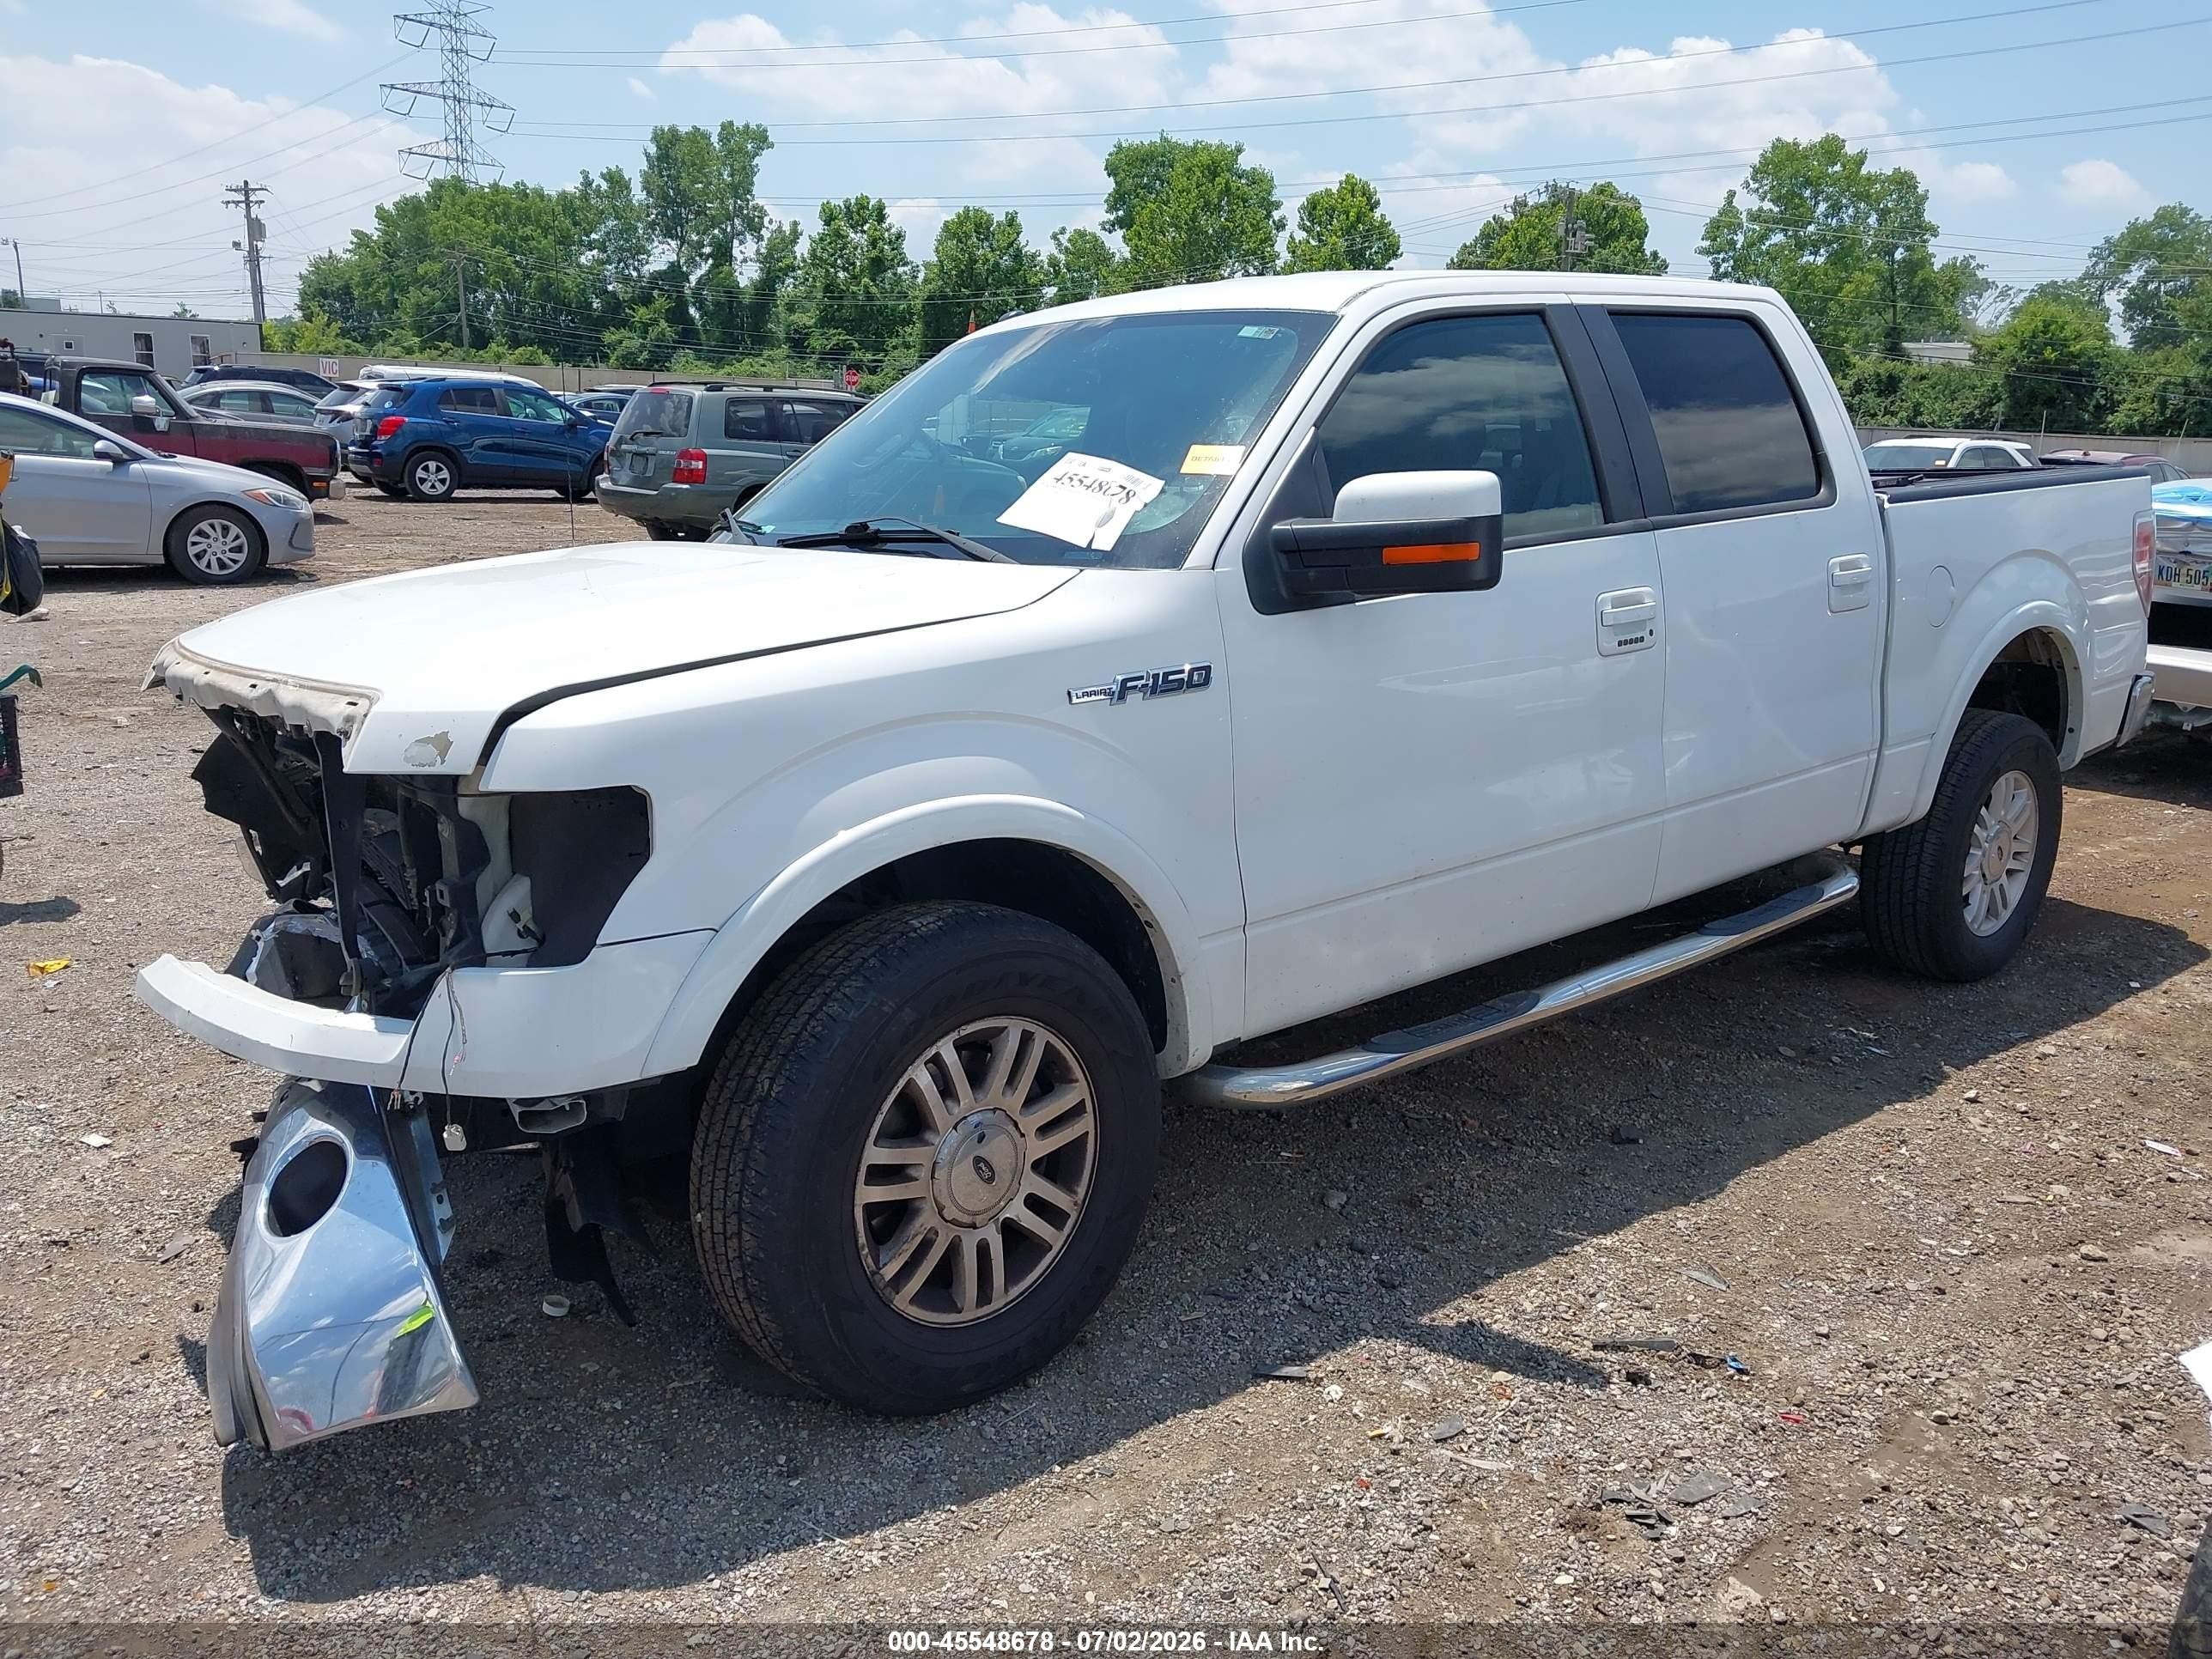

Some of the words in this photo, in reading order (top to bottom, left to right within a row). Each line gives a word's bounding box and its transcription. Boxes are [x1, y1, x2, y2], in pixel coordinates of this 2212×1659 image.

[320, 361, 338, 375] VIC
[2157, 564, 2182, 583] KDH
[2185, 568, 2212, 586] 505
[1116, 664, 1212, 702] F-150
[1075, 686, 1115, 700] LARIAT
